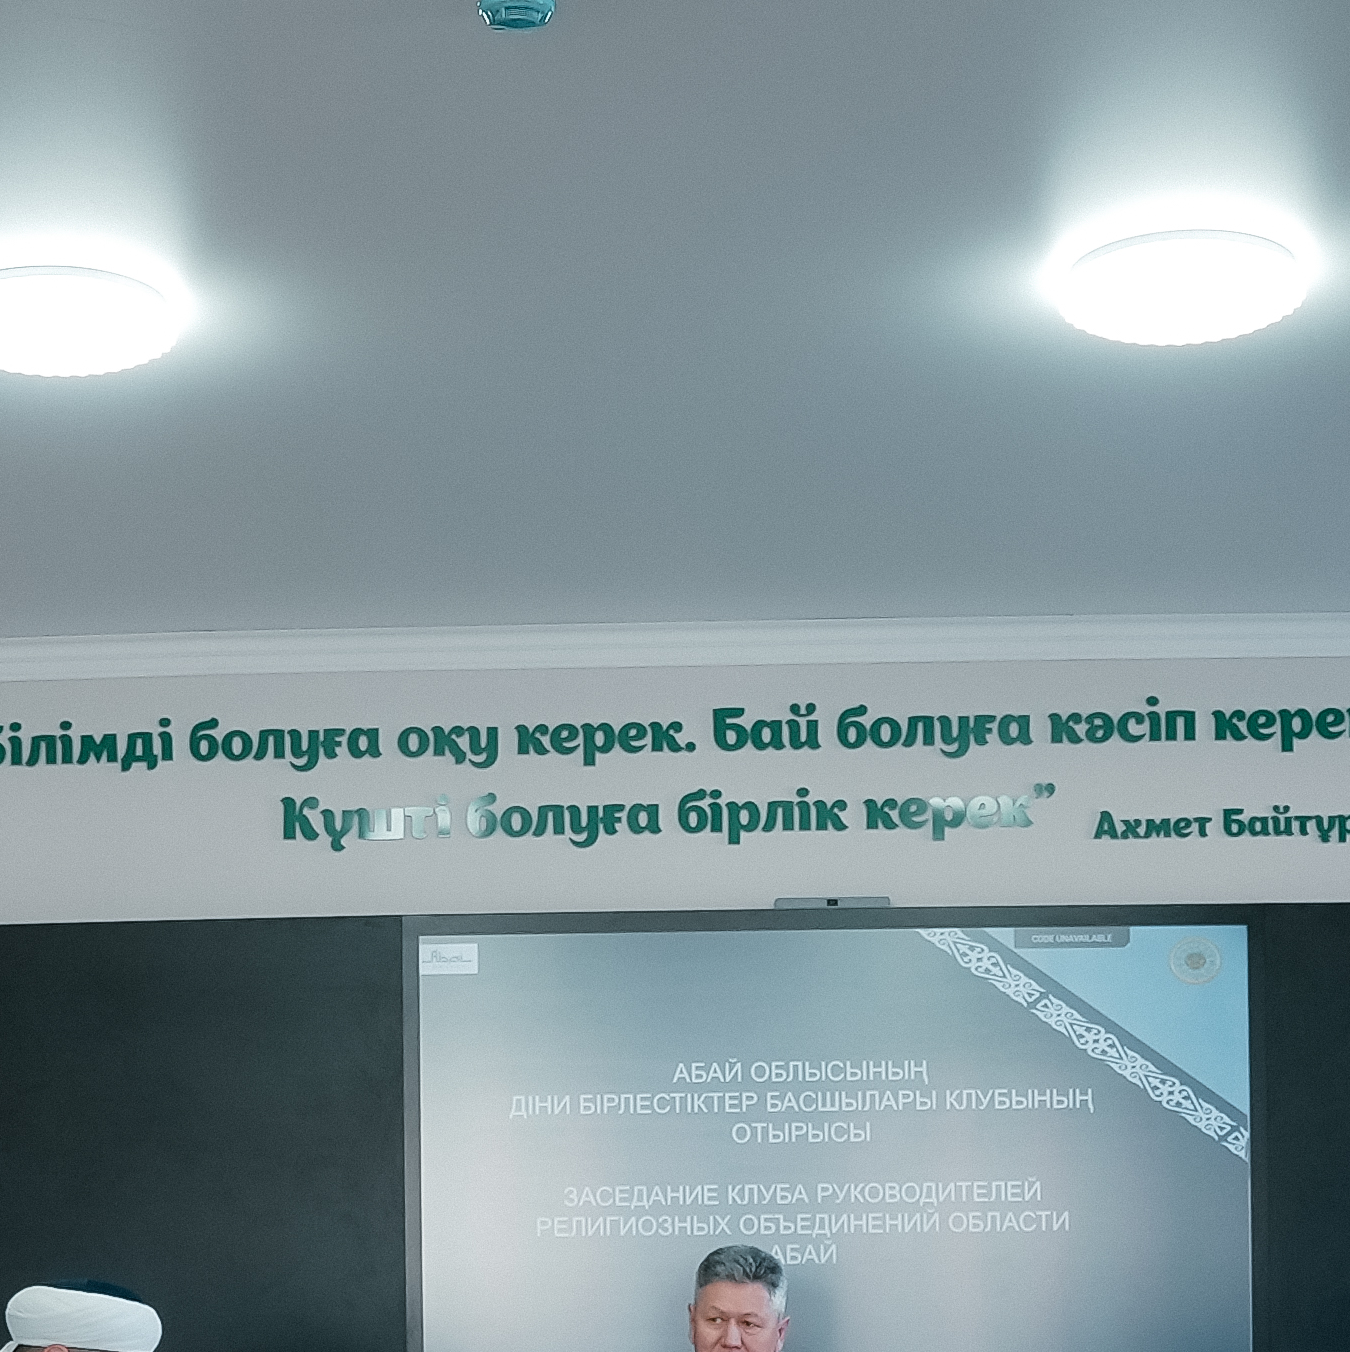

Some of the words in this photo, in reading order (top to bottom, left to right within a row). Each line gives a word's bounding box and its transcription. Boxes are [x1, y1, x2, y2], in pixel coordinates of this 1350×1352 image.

[189, 717, 381, 772] болуға
[397, 724, 498, 768] оқу
[516, 718, 696, 766] керек.
[712, 702, 821, 752] Бай
[837, 704, 1032, 758] болуға
[1048, 696, 1197, 744] кәсіп
[281, 793, 452, 852] Күшті
[465, 792, 663, 849] болуға
[677, 788, 849, 845] бірлік
[863, 782, 1056, 841] керек”
[1093, 810, 1210, 841] Ахмет
[672, 1058, 743, 1083] АБАЙ
[750, 1059, 929, 1085] ОБЛЫСЫНЫҢ
[509, 1094, 571, 1119] ДІНИ
[579, 1091, 758, 1115] БІРЛЕСТІКТЕР
[766, 1089, 937, 1113] БАСШЫЛАРЫ
[945, 1087, 1095, 1113] КЛУБЫНЫҢ
[731, 1121, 872, 1144] ОТЫРЫСЫ
[563, 1185, 720, 1210] ЗАСЕДАНИЕ
[727, 1183, 810, 1206] КЛУБА
[816, 1176, 1042, 1206] РУКОВОДИТЕЛЕЙ
[536, 1216, 733, 1238] РЕЛИГИОЗНЫХ
[739, 1208, 941, 1238] ОБЪЕДИНЕНИЙ
[948, 1211, 1070, 1234] ОБЛАСТИ
